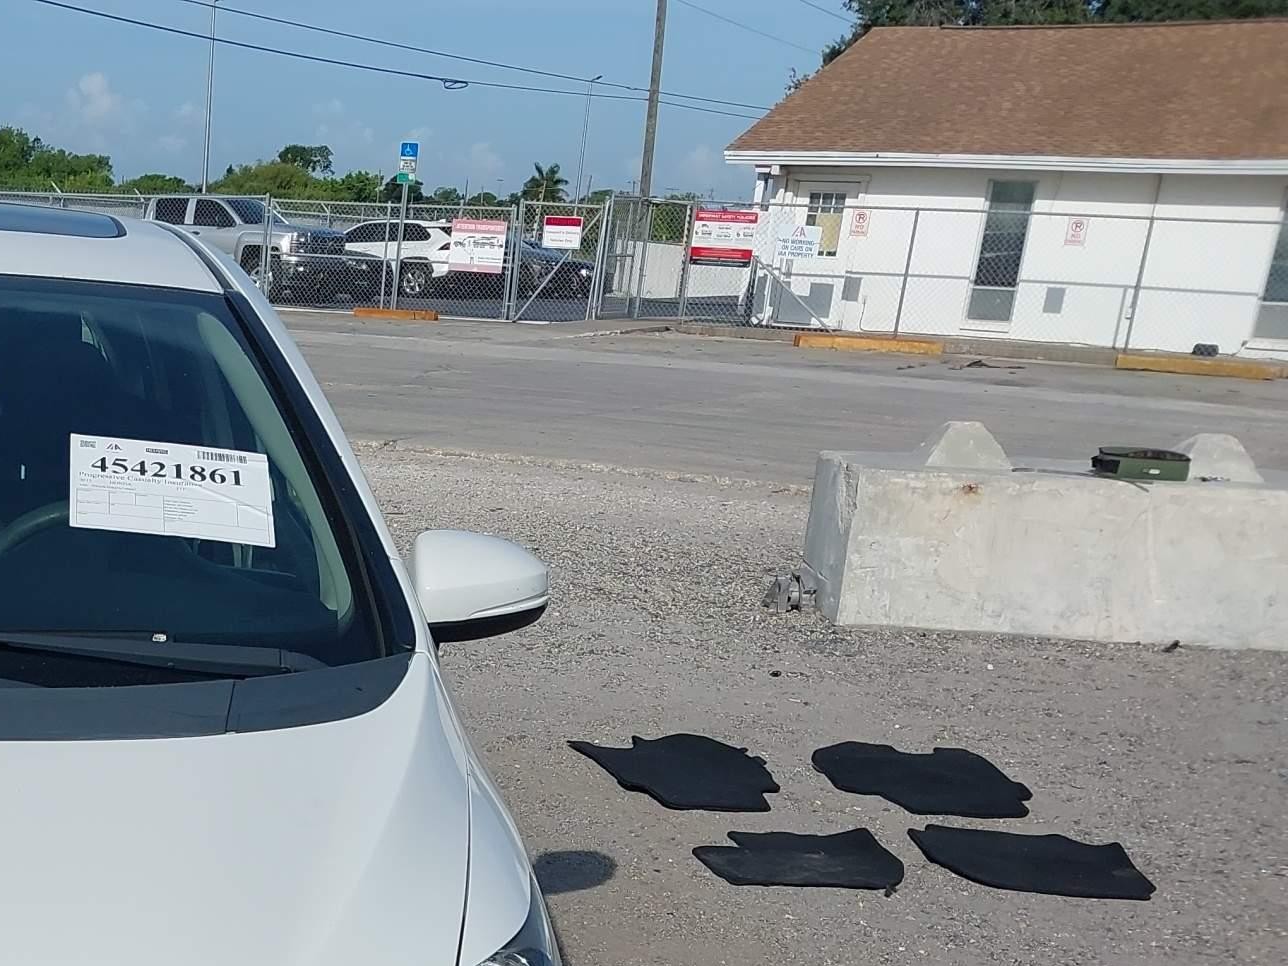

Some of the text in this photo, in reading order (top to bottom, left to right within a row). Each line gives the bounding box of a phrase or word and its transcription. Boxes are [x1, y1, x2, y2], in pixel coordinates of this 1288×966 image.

[788, 251, 814, 259] PROPERTY
[79, 471, 125, 481] Progressive
[127, 475, 161, 485] Casualty
[90, 455, 244, 487] 45421861
